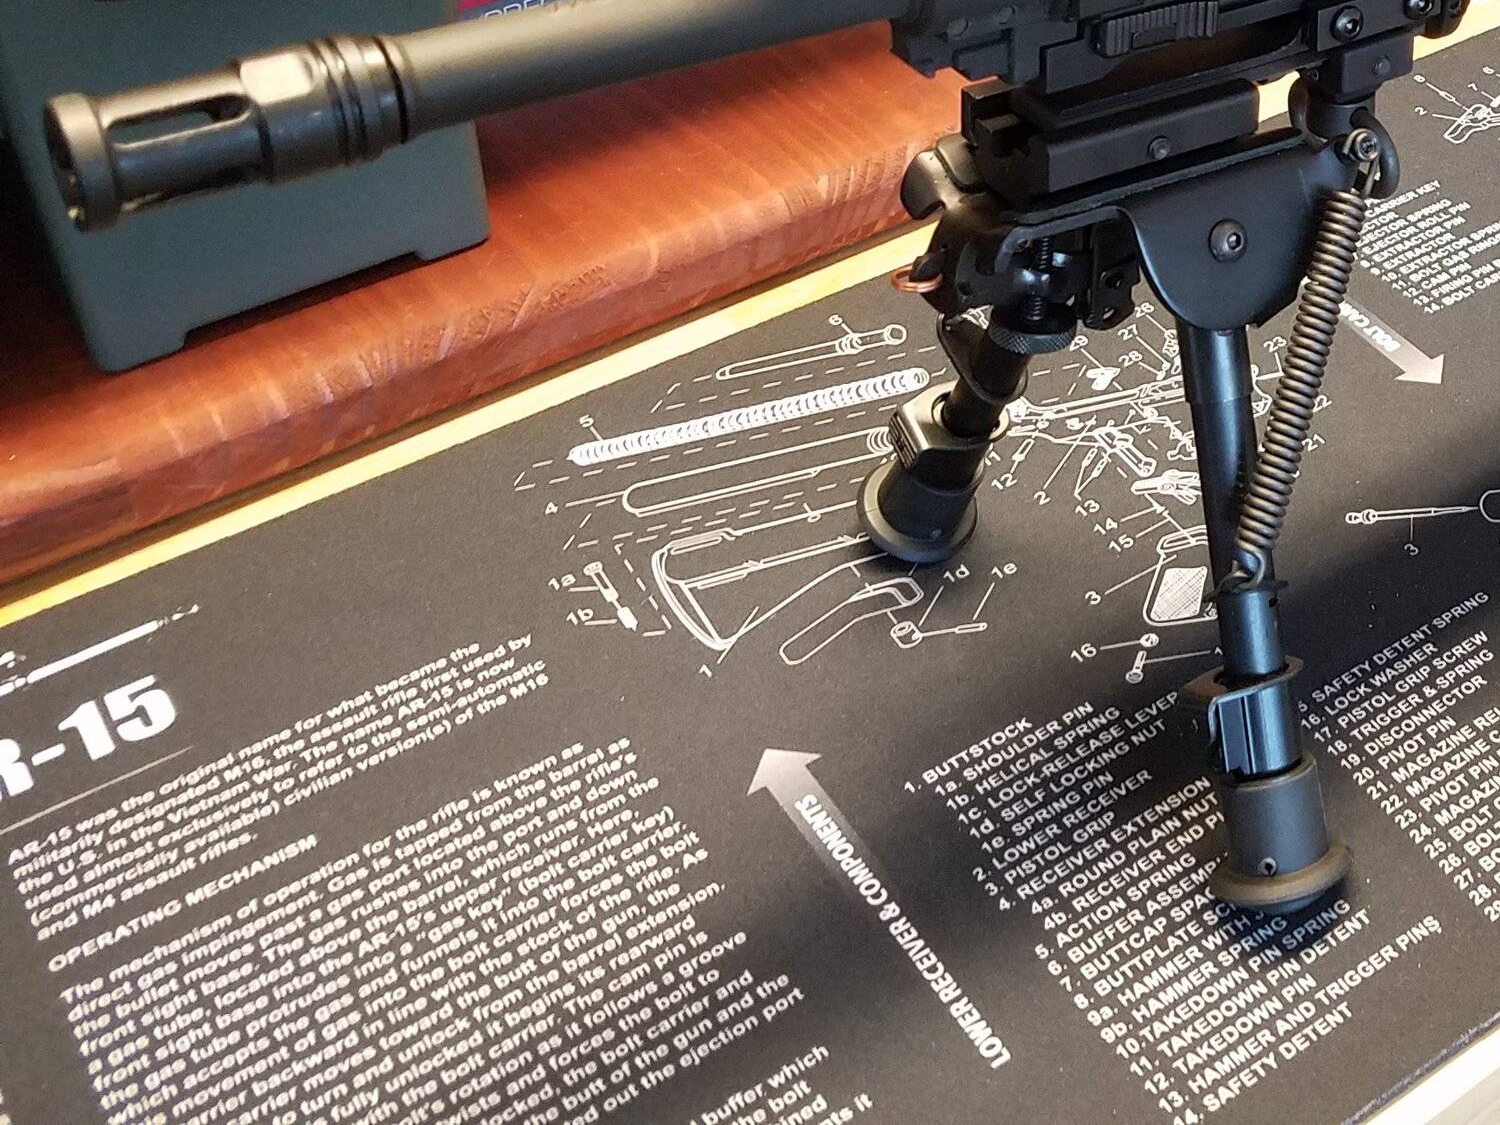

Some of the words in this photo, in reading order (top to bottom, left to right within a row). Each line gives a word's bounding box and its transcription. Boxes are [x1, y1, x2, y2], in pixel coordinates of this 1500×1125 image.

[548, 574, 578, 592] 1a
[943, 563, 970, 583] 1d
[991, 562, 1018, 579] 1e
[565, 608, 596, 626] 1b
[1070, 643, 1097, 663] 16
[8, 825, 73, 866] AR-15
[75, 807, 119, 833] was
[120, 790, 155, 812] the
[159, 752, 235, 796] original
[237, 728, 292, 761] name
[294, 714, 322, 734] for
[326, 690, 374, 719] what
[374, 657, 448, 697] became
[449, 643, 480, 663] the
[922, 717, 1033, 785] BUTTSTOCK
[962, 720, 1062, 781] SHOULDER
[1062, 701, 1094, 725] PIN
[1390, 724, 1477, 784] MAGAZINE
[794, 793, 888, 906] COMPONENTS
[1447, 804, 1494, 842] BOLT
[48, 899, 182, 972] OPERATING
[184, 834, 318, 907] MECHANISM
[879, 901, 900, 921] &
[889, 916, 961, 1004] RECEIVER
[1156, 979, 1268, 1058] TAKEDOWN
[1266, 958, 1301, 987] PIN
[1299, 908, 1370, 965] DETENT
[949, 996, 1011, 1069] LOWER
[1187, 1028, 1277, 1094] HAMMER
[1275, 1001, 1316, 1037] AND
[1314, 944, 1400, 1006] TRIGGER
[1395, 915, 1442, 952] PINS
